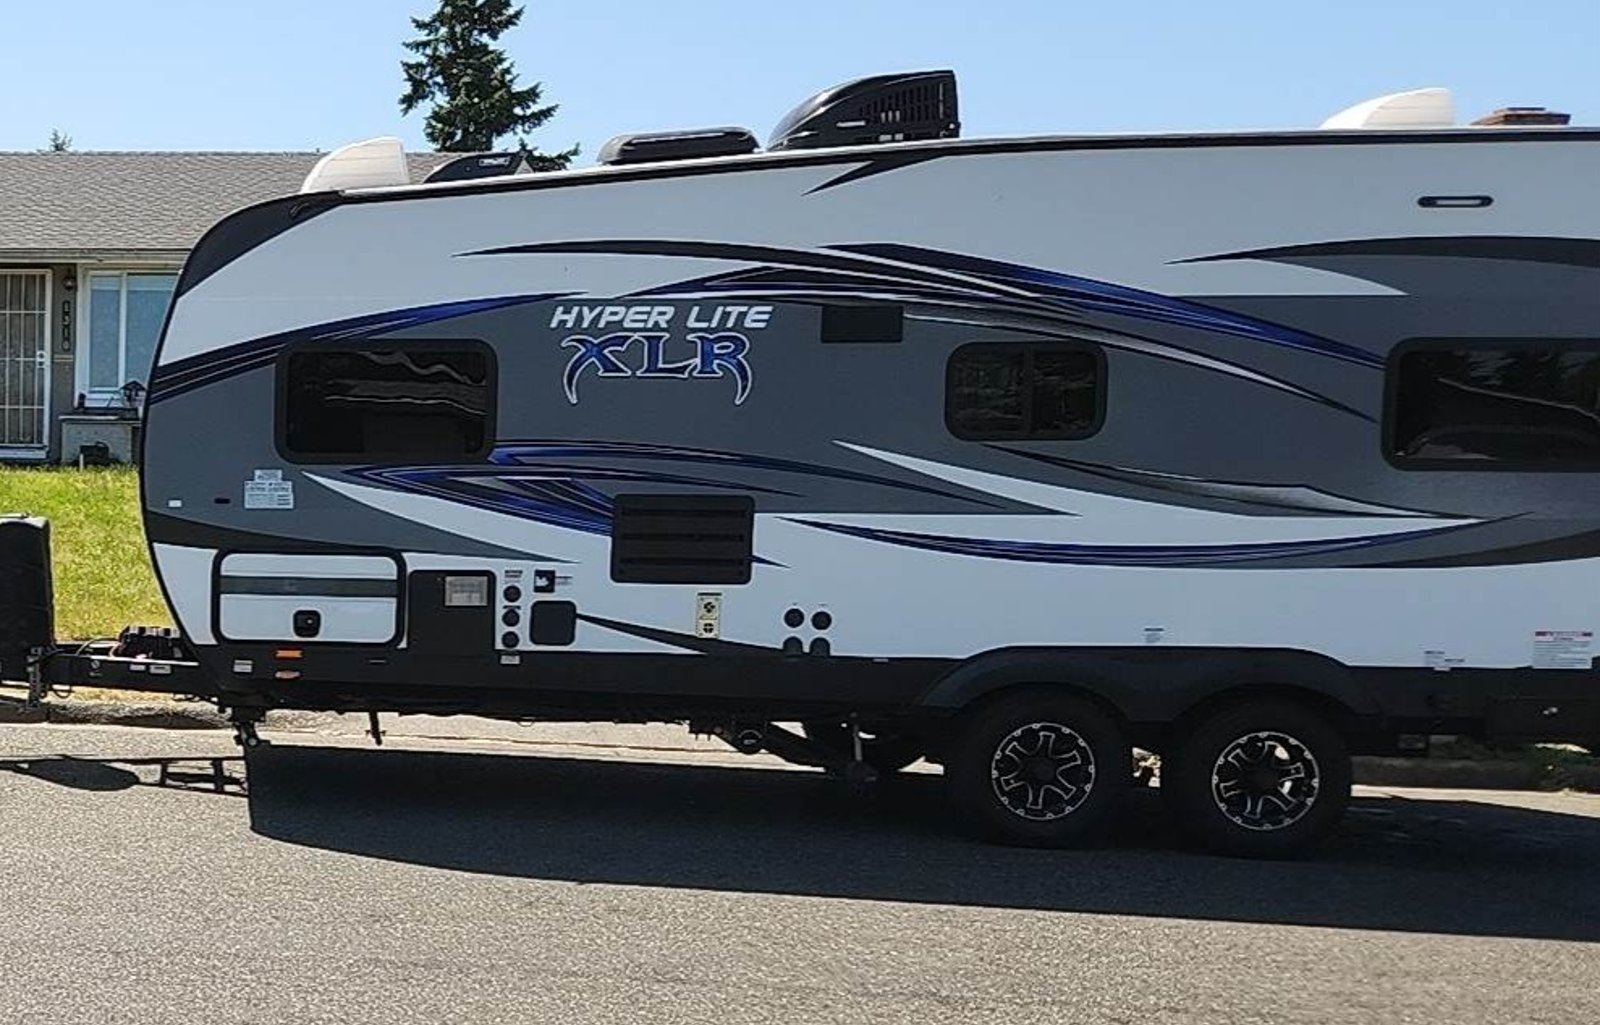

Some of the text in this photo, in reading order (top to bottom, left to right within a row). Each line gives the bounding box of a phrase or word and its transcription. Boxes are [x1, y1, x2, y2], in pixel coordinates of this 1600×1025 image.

[549, 305, 775, 329] HYPER LITE
[560, 331, 753, 406] XLR
